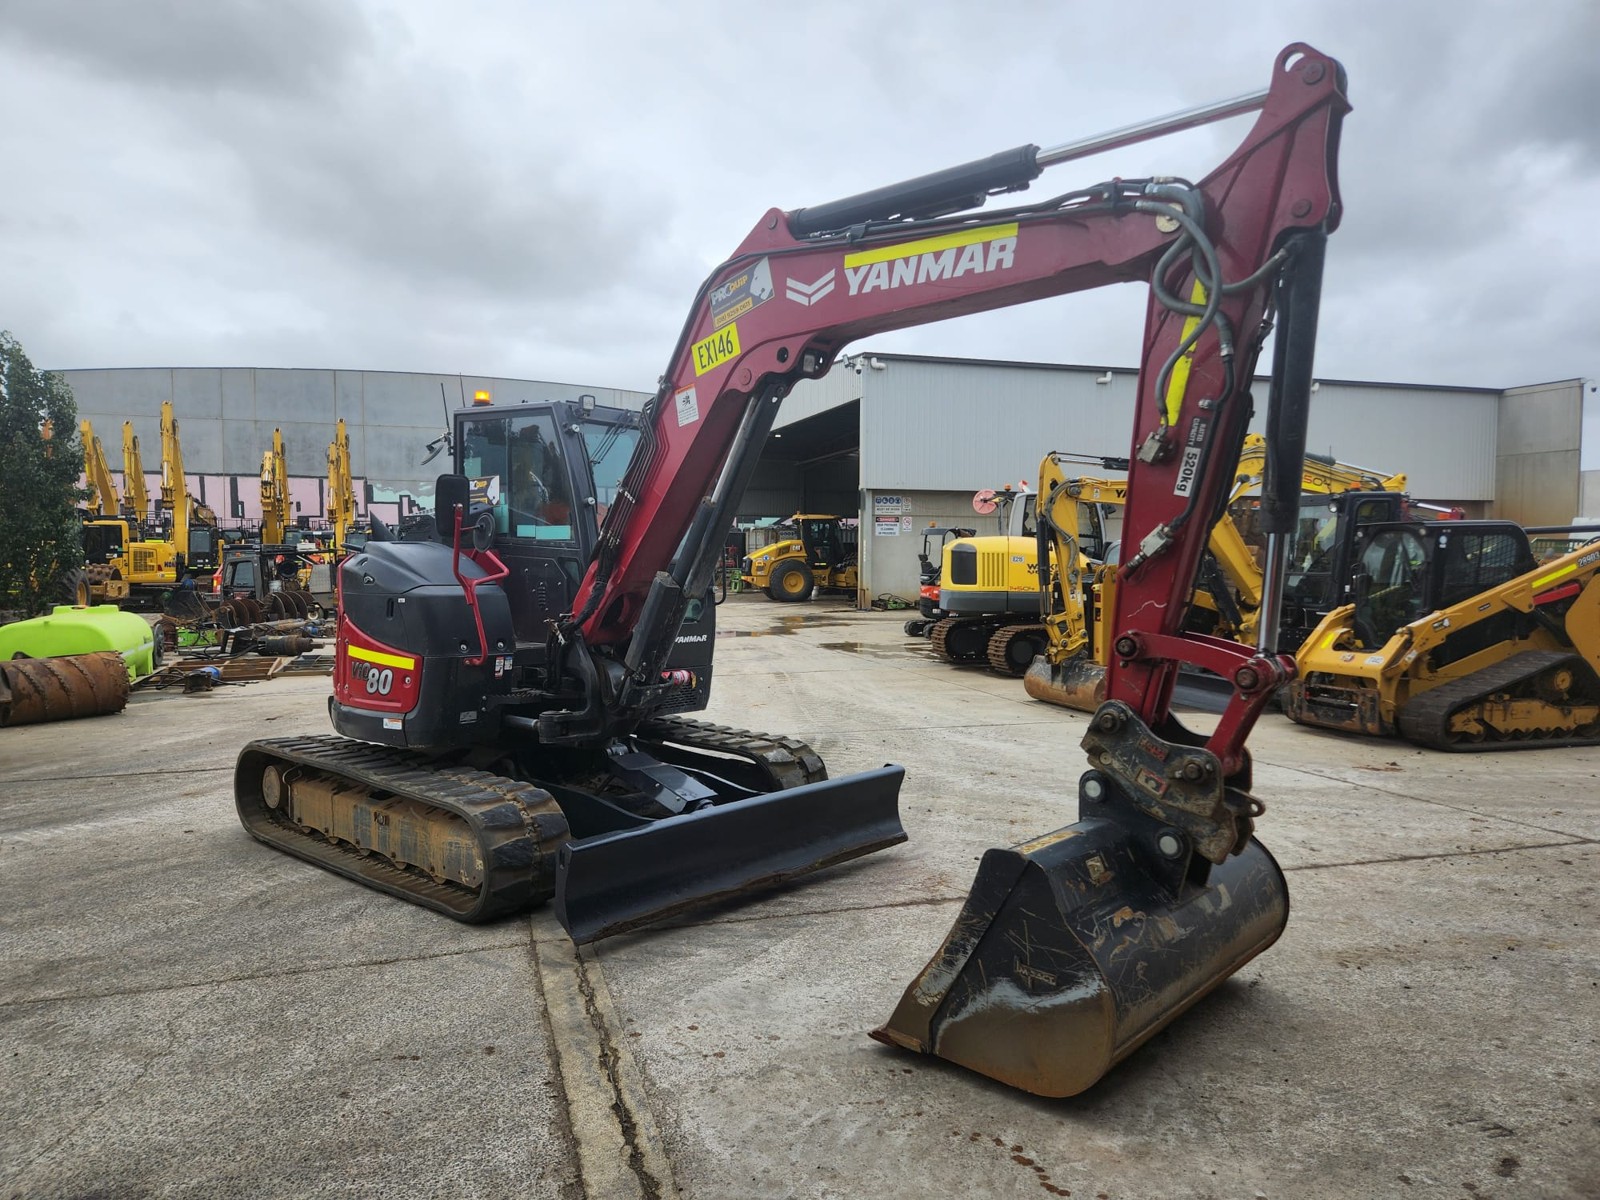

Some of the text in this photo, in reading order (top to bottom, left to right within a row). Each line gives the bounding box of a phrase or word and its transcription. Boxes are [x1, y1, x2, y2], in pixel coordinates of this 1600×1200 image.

[844, 236, 1018, 296] YANMAR
[697, 329, 734, 369] EX146
[1196, 423, 1207, 442] RATED
[1176, 451, 1198, 492] 520kg
